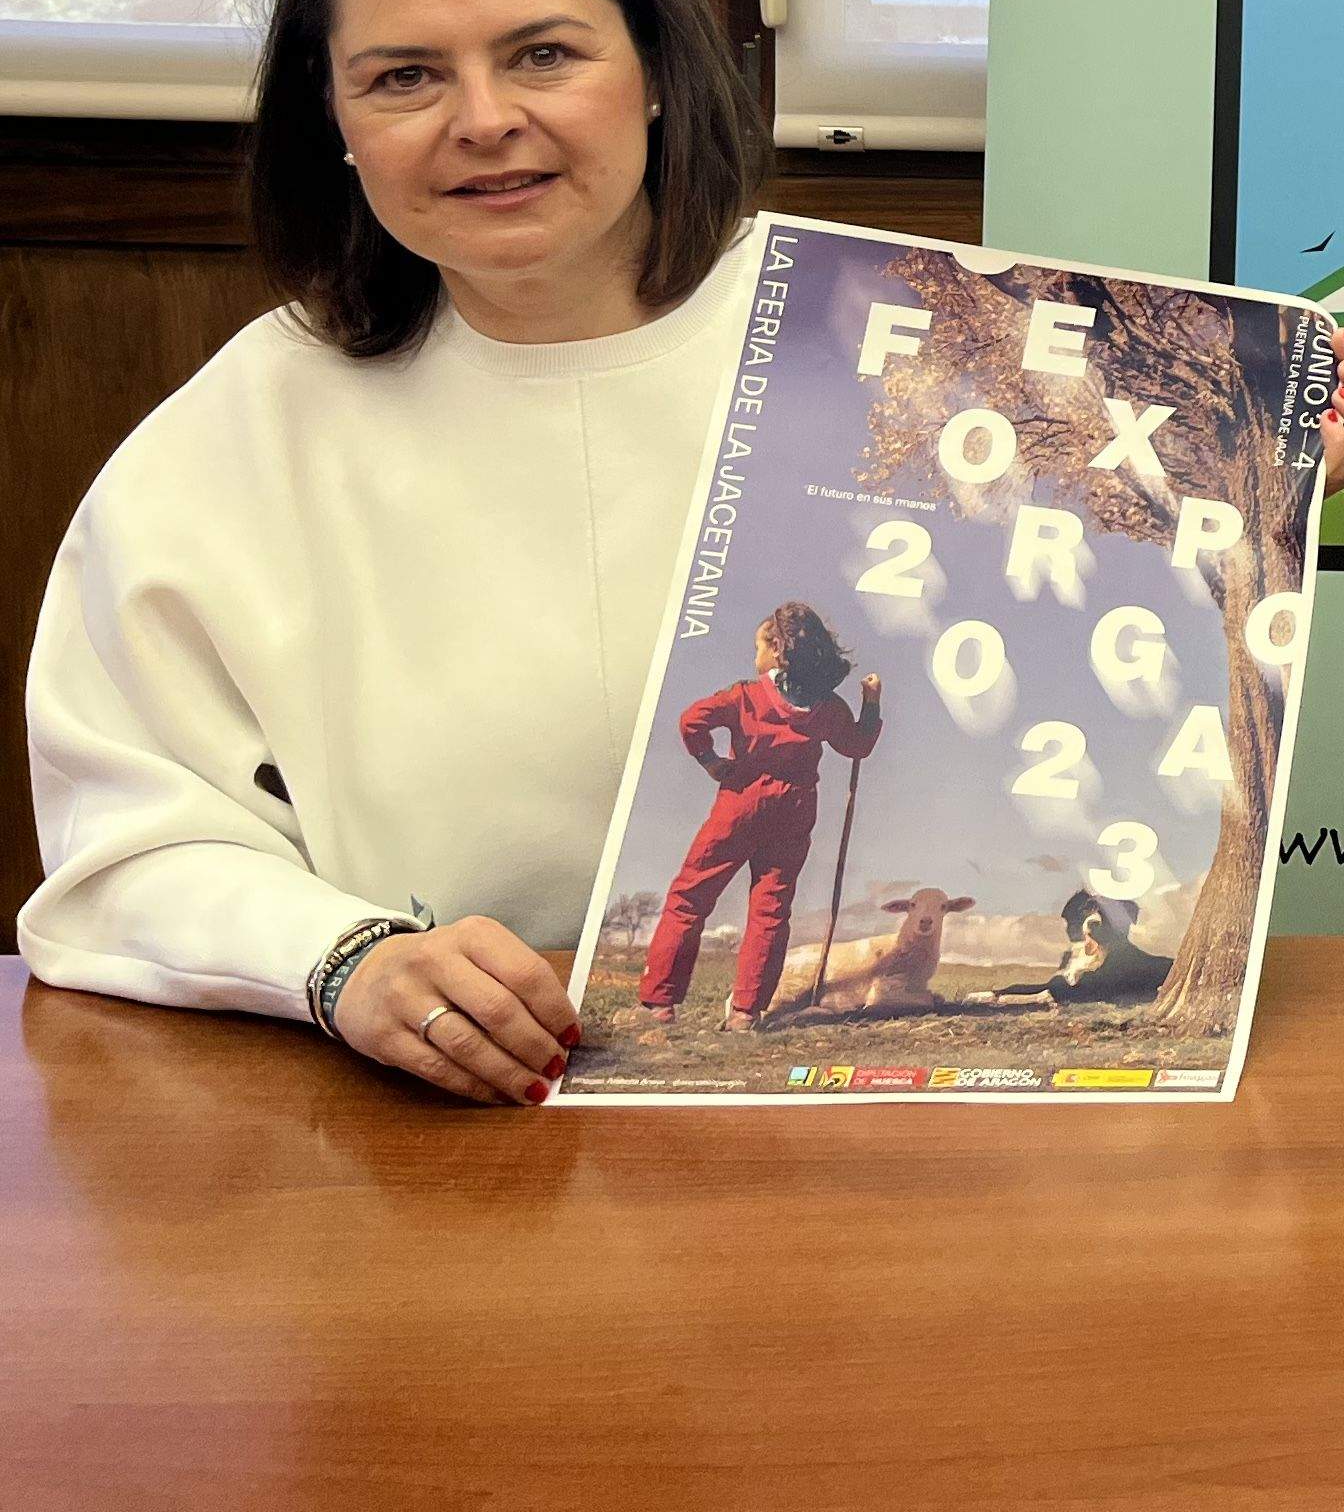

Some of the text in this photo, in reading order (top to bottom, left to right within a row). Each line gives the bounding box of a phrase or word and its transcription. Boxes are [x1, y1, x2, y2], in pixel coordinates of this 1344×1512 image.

[680, 234, 798, 640] LA FERIA DE LA JACETANIA
[1272, 315, 1310, 467] PUENTE LA REINA DE JACA
[820, 486, 854, 501] futuro
[856, 492, 871, 503] en
